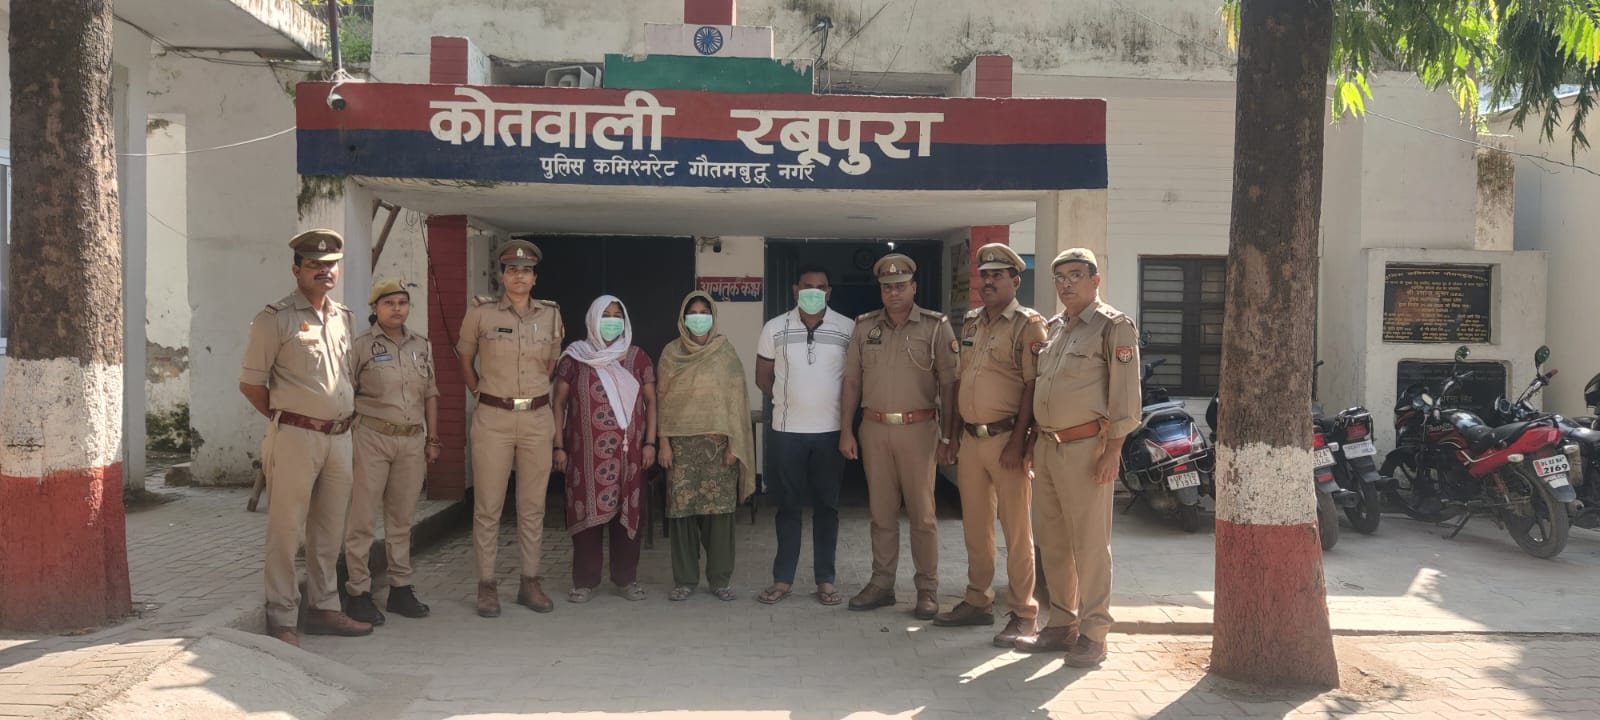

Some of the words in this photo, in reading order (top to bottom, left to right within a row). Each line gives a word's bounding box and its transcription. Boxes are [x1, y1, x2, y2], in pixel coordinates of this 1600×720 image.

[429, 87, 676, 151] कोतवाली
[729, 109, 945, 175] रबूपुरा
[539, 153, 586, 179] पुलिस
[593, 153, 679, 179] कमिश्नरेट
[777, 164, 816, 182] नगर
[1543, 463, 1568, 474] 2169
